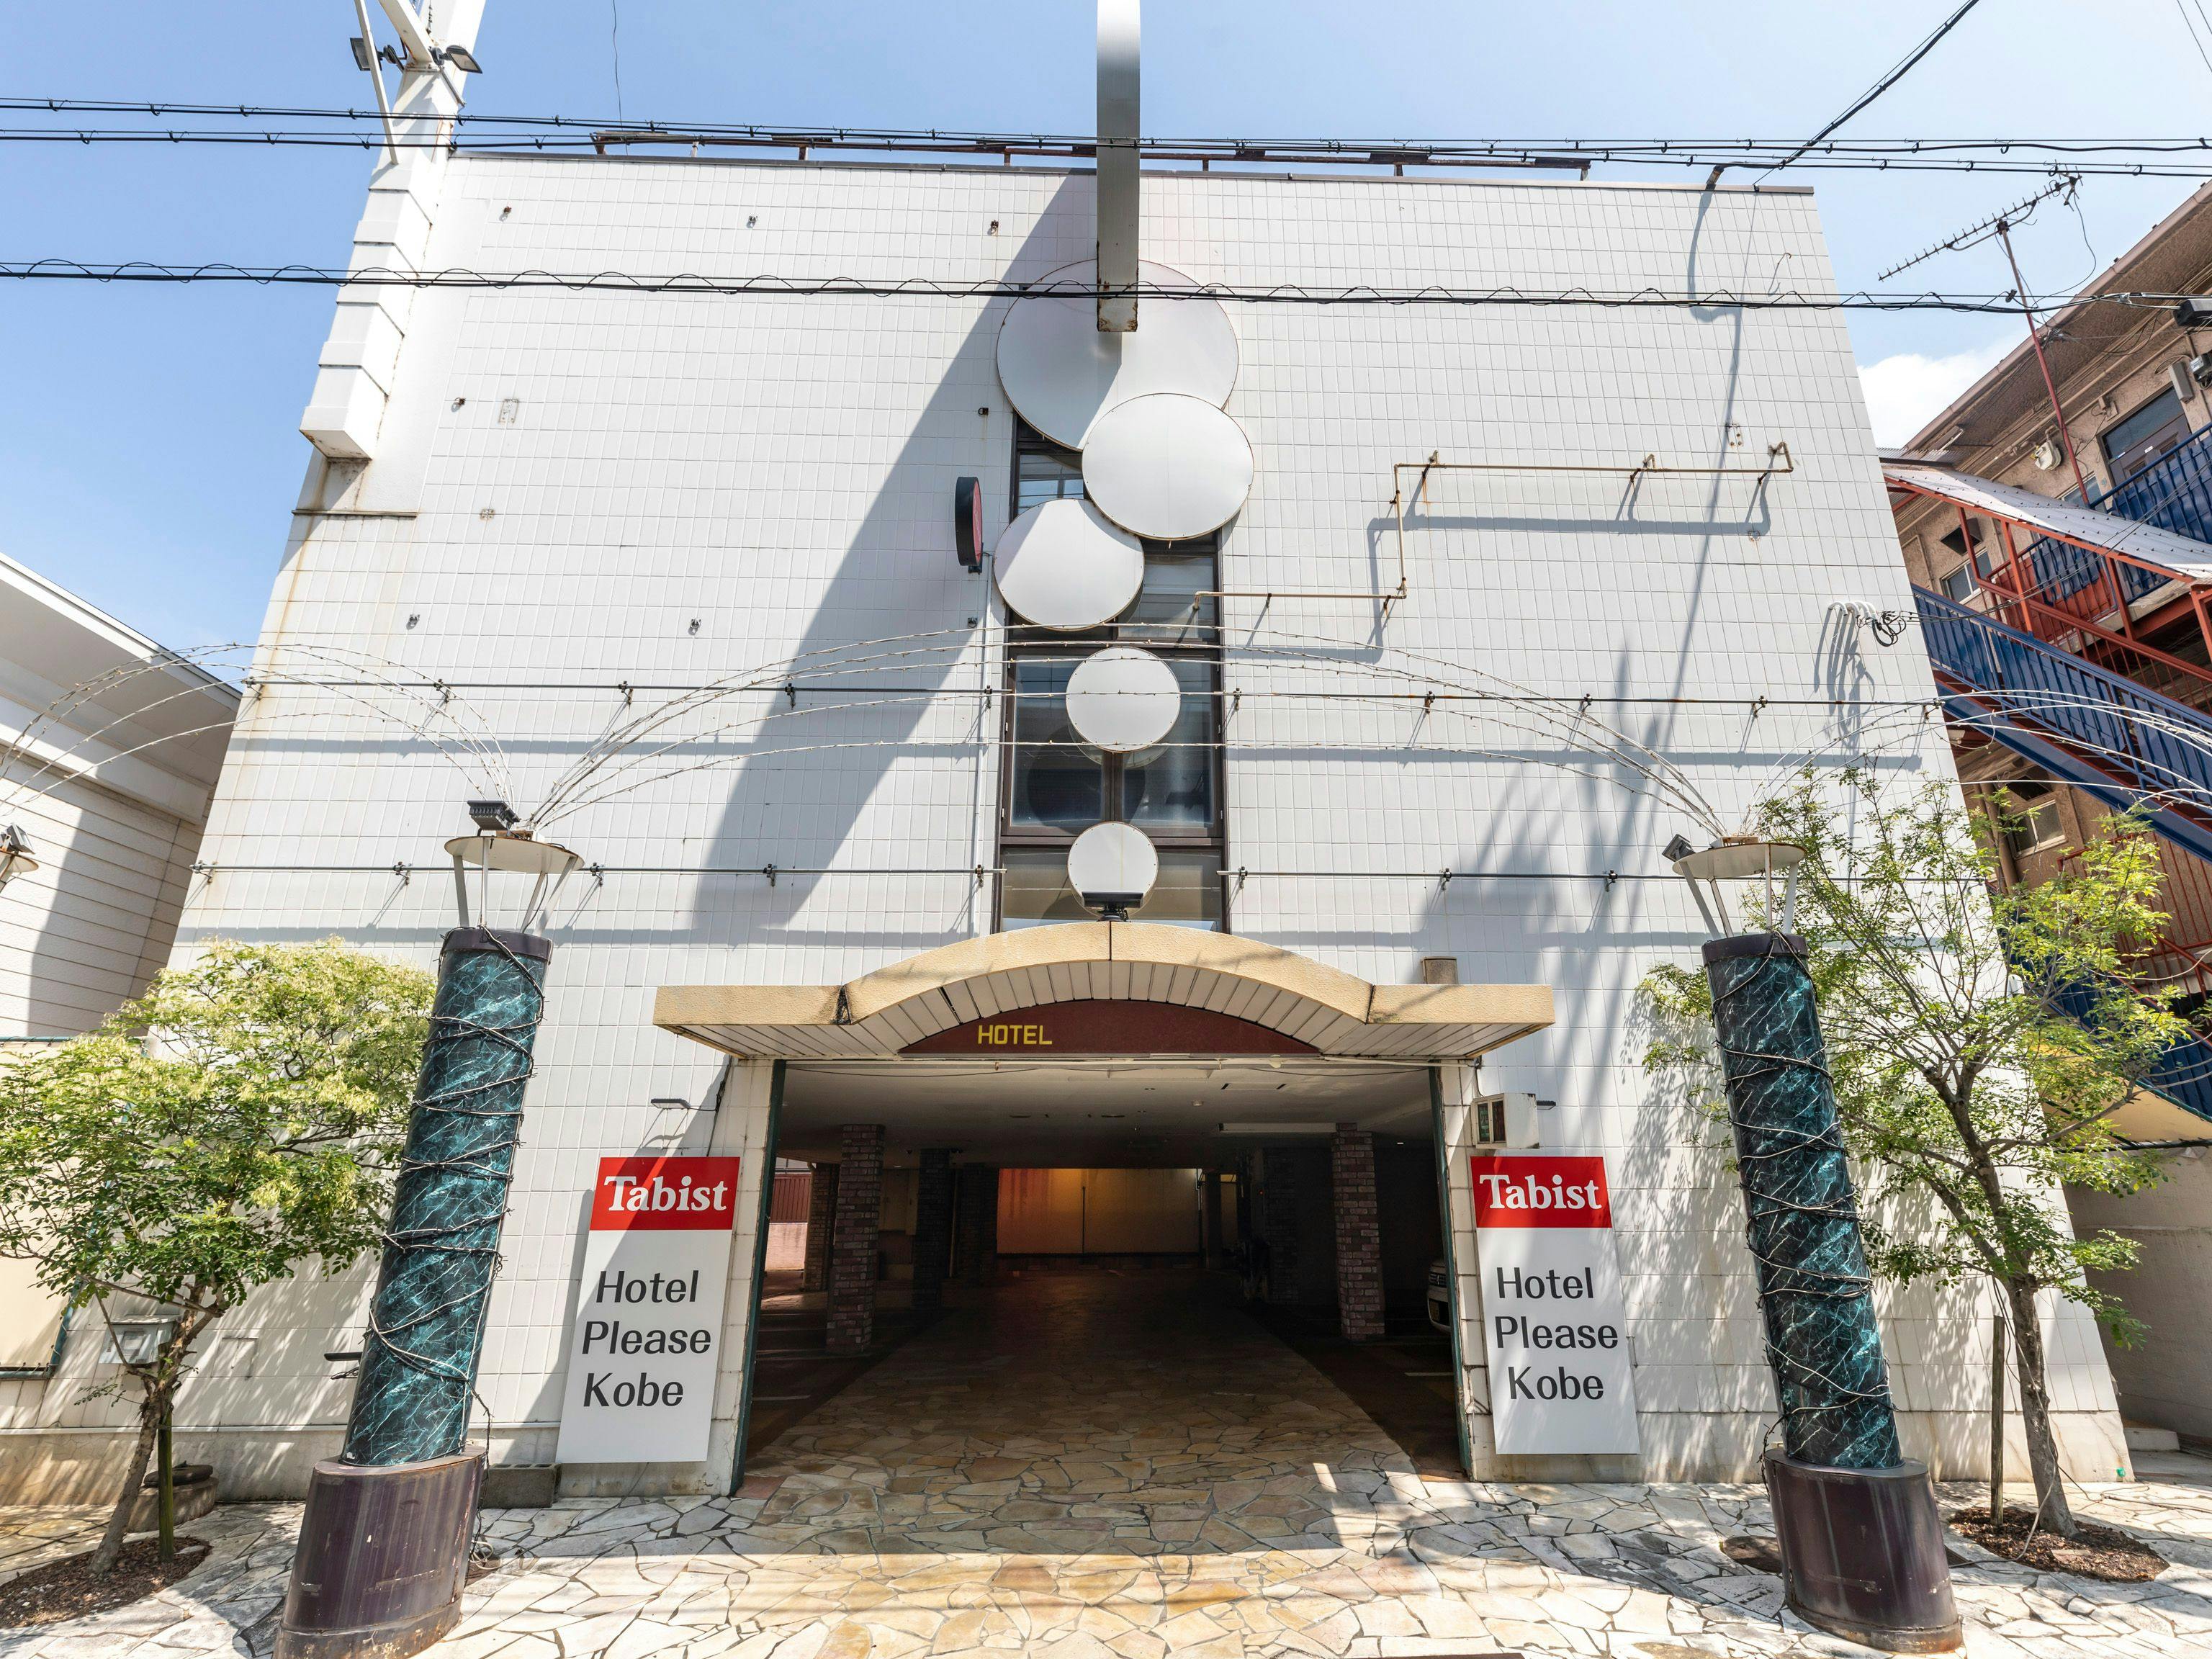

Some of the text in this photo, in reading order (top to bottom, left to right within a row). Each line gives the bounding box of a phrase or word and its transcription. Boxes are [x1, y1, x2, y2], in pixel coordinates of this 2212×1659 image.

[978, 1025, 1053, 1045] HOTEL
[603, 1175, 728, 1212] Tabist
[1479, 1174, 1602, 1210] Tabist
[595, 1269, 699, 1303] Hotel
[1496, 1267, 1594, 1299] Hotel
[582, 1321, 711, 1354] Please
[1495, 1316, 1619, 1349] Please
[583, 1372, 683, 1407] Kobe
[1508, 1366, 1604, 1401] Kobe
